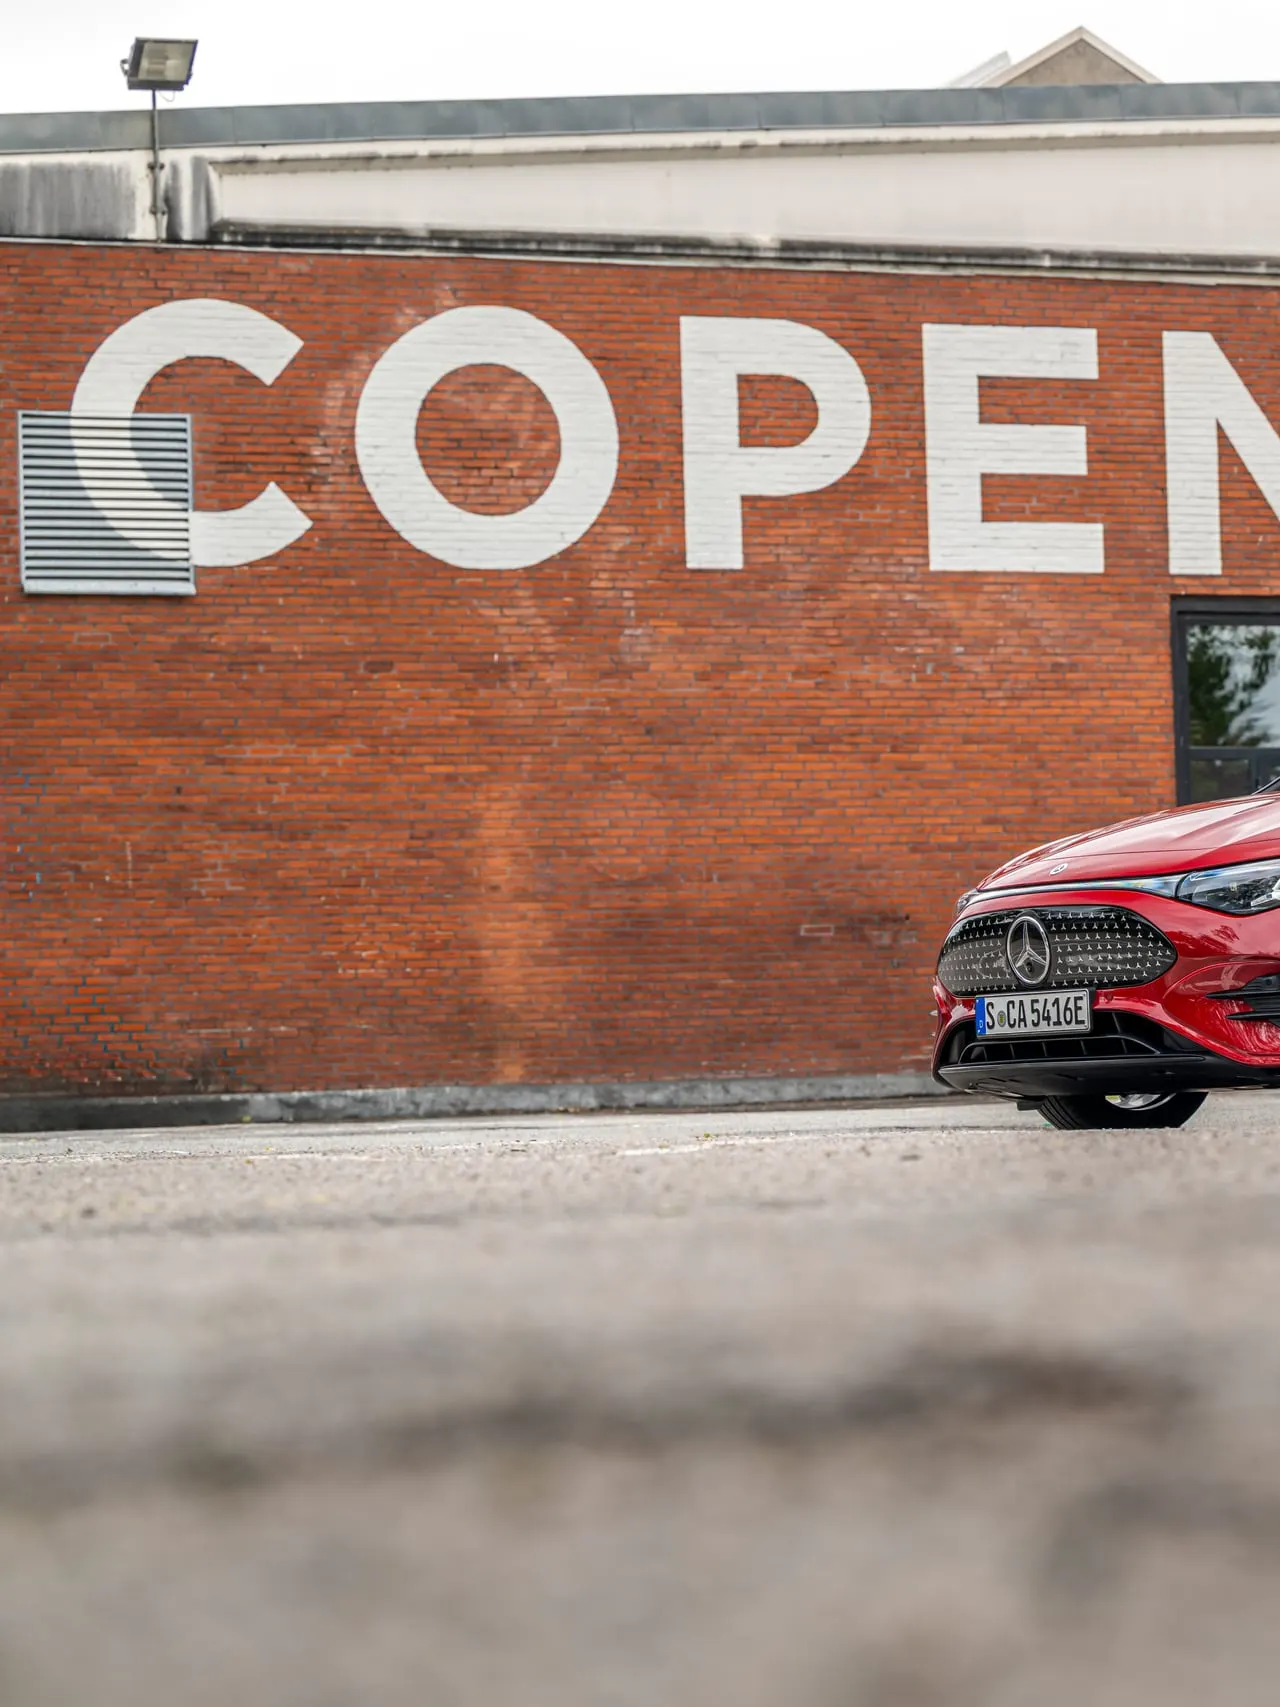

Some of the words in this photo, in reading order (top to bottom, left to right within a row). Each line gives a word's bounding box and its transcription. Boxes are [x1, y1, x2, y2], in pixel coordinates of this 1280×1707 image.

[986, 1001, 995, 1030] S
[1006, 999, 1028, 1029] CA
[1030, 995, 1086, 1028] 5416E
